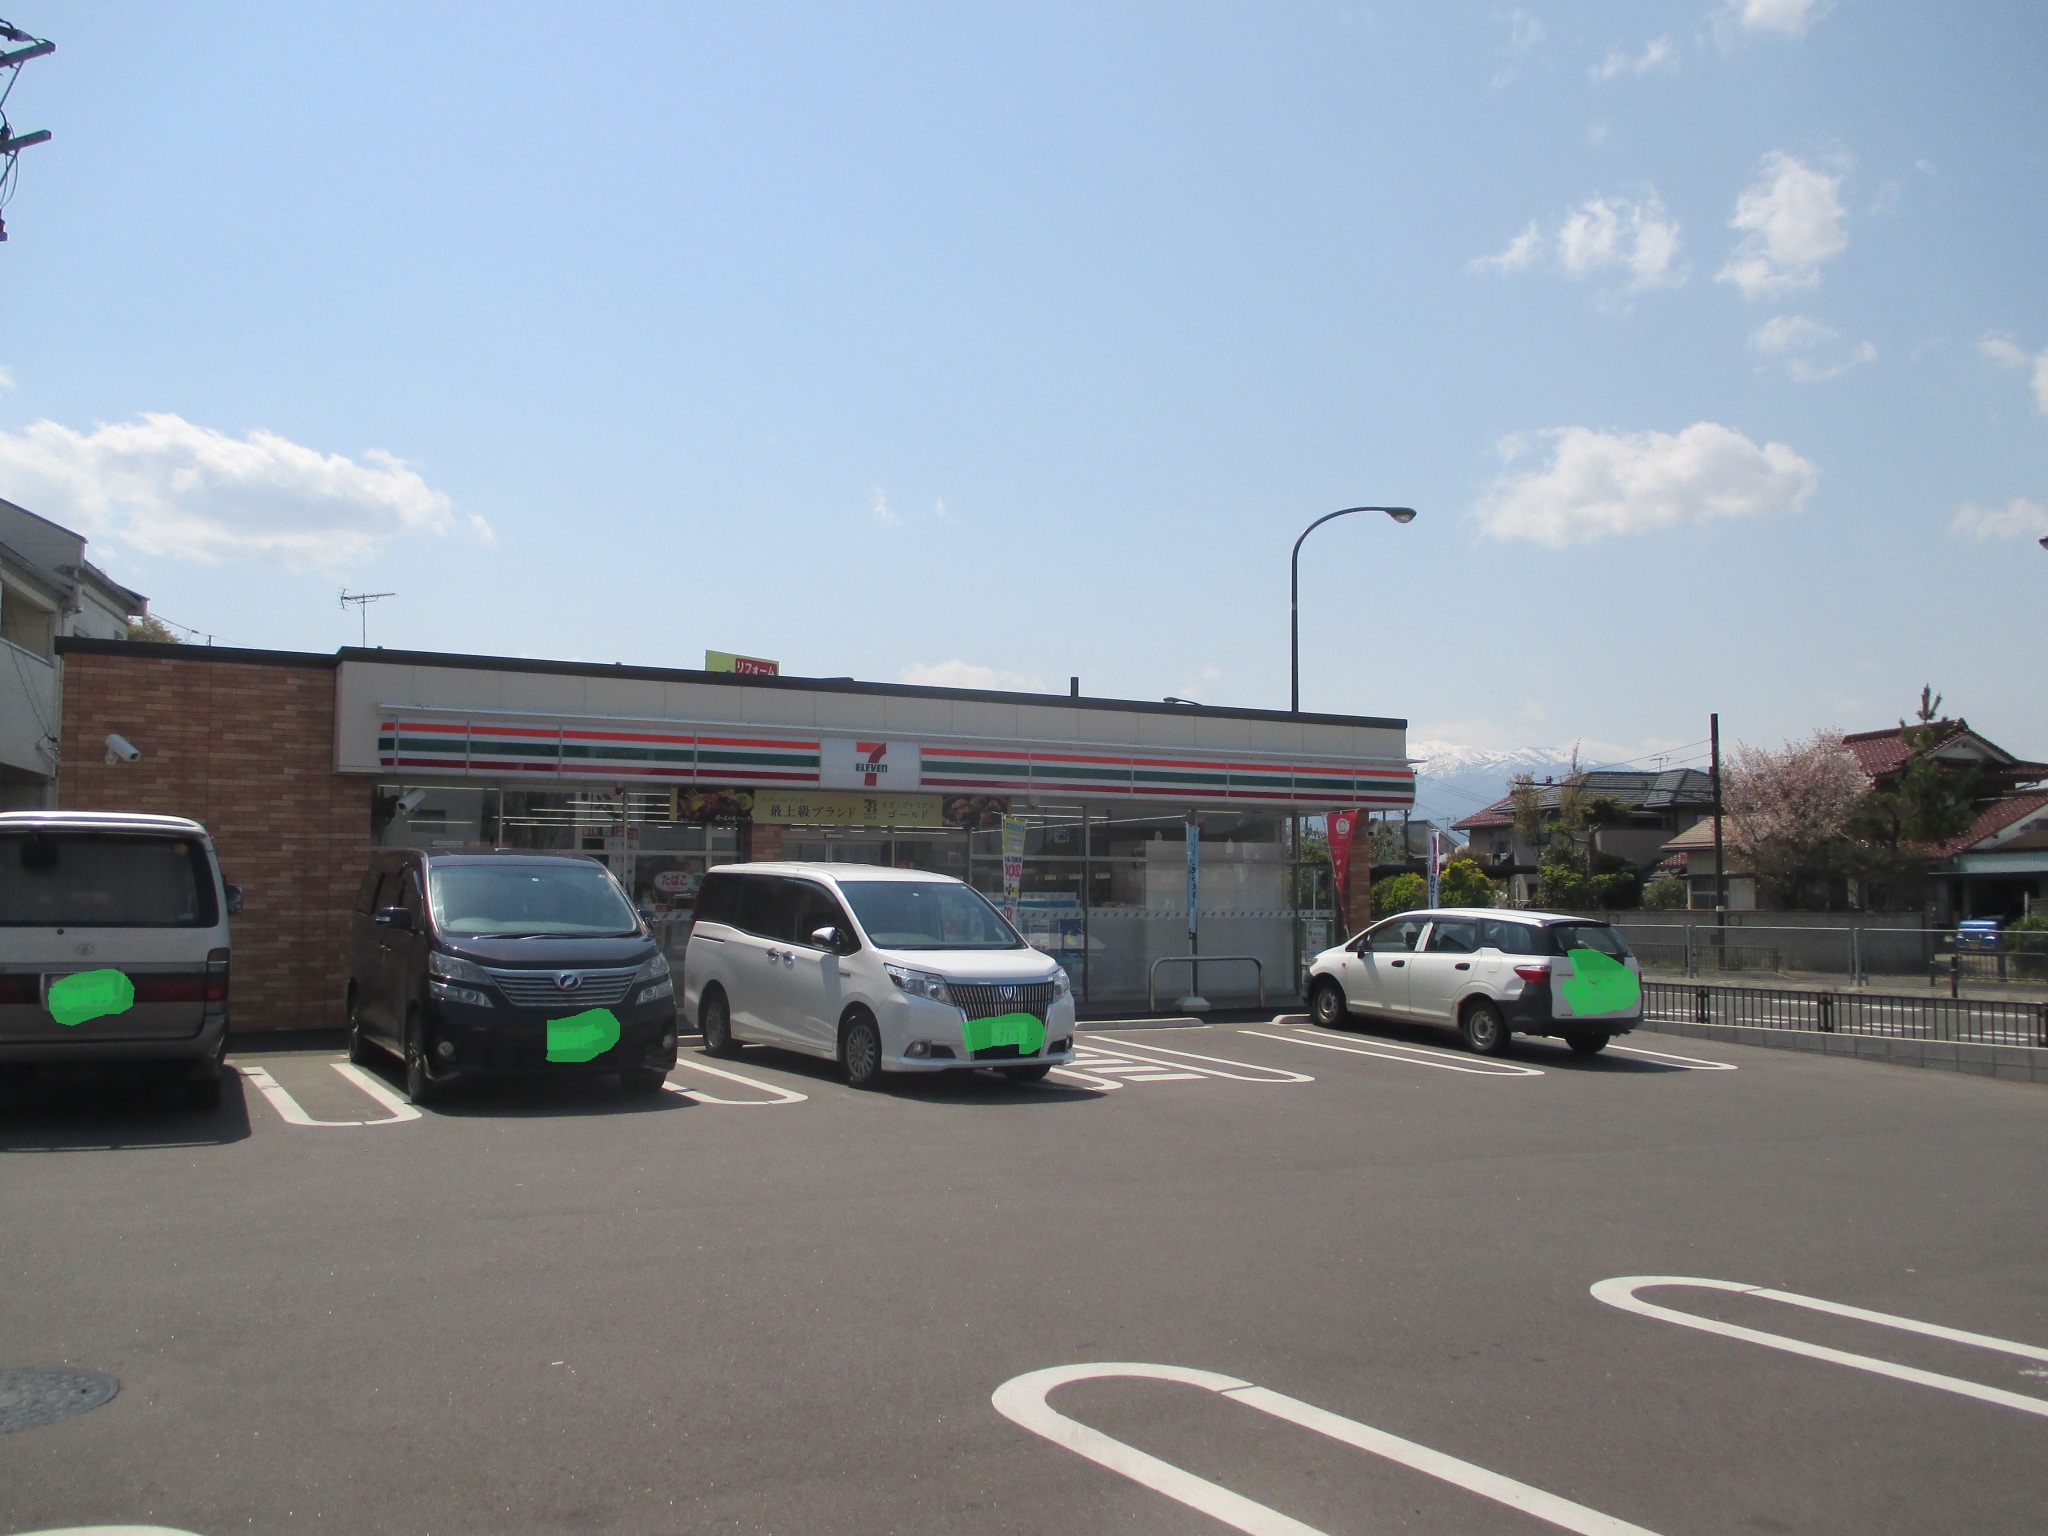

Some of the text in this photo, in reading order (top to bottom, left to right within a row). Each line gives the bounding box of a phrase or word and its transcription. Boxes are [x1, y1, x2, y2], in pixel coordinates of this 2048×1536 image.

[737, 662, 775, 676] リフォーム
[770, 804, 857, 818] 最上級ブランド
[887, 810, 929, 819] ゴールド
[661, 874, 688, 886] たばこ
